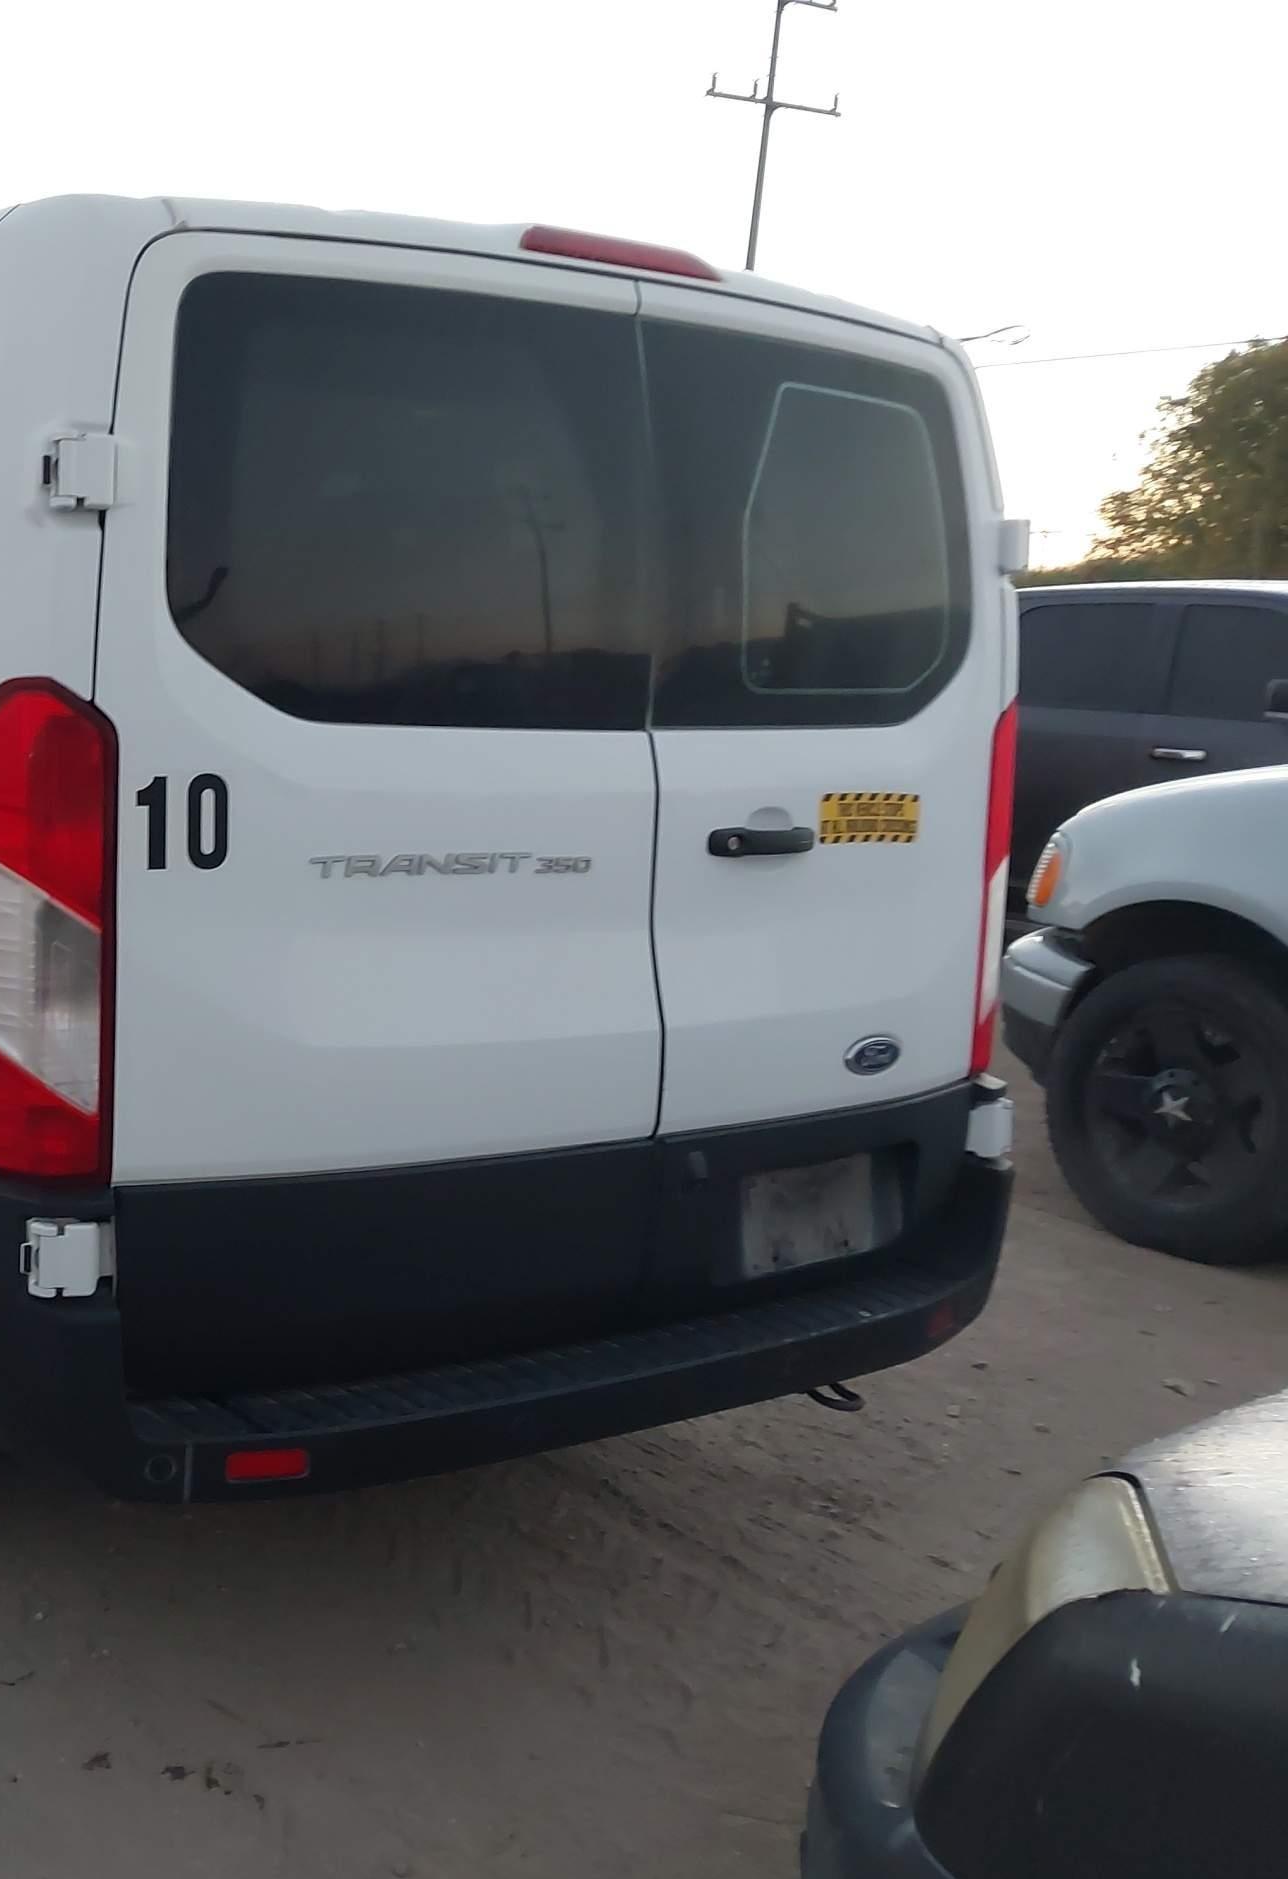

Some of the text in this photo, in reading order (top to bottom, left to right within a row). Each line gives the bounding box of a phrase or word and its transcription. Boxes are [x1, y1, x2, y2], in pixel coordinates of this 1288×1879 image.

[136, 772, 229, 870] 10
[308, 852, 593, 879] TRANSIT 350
